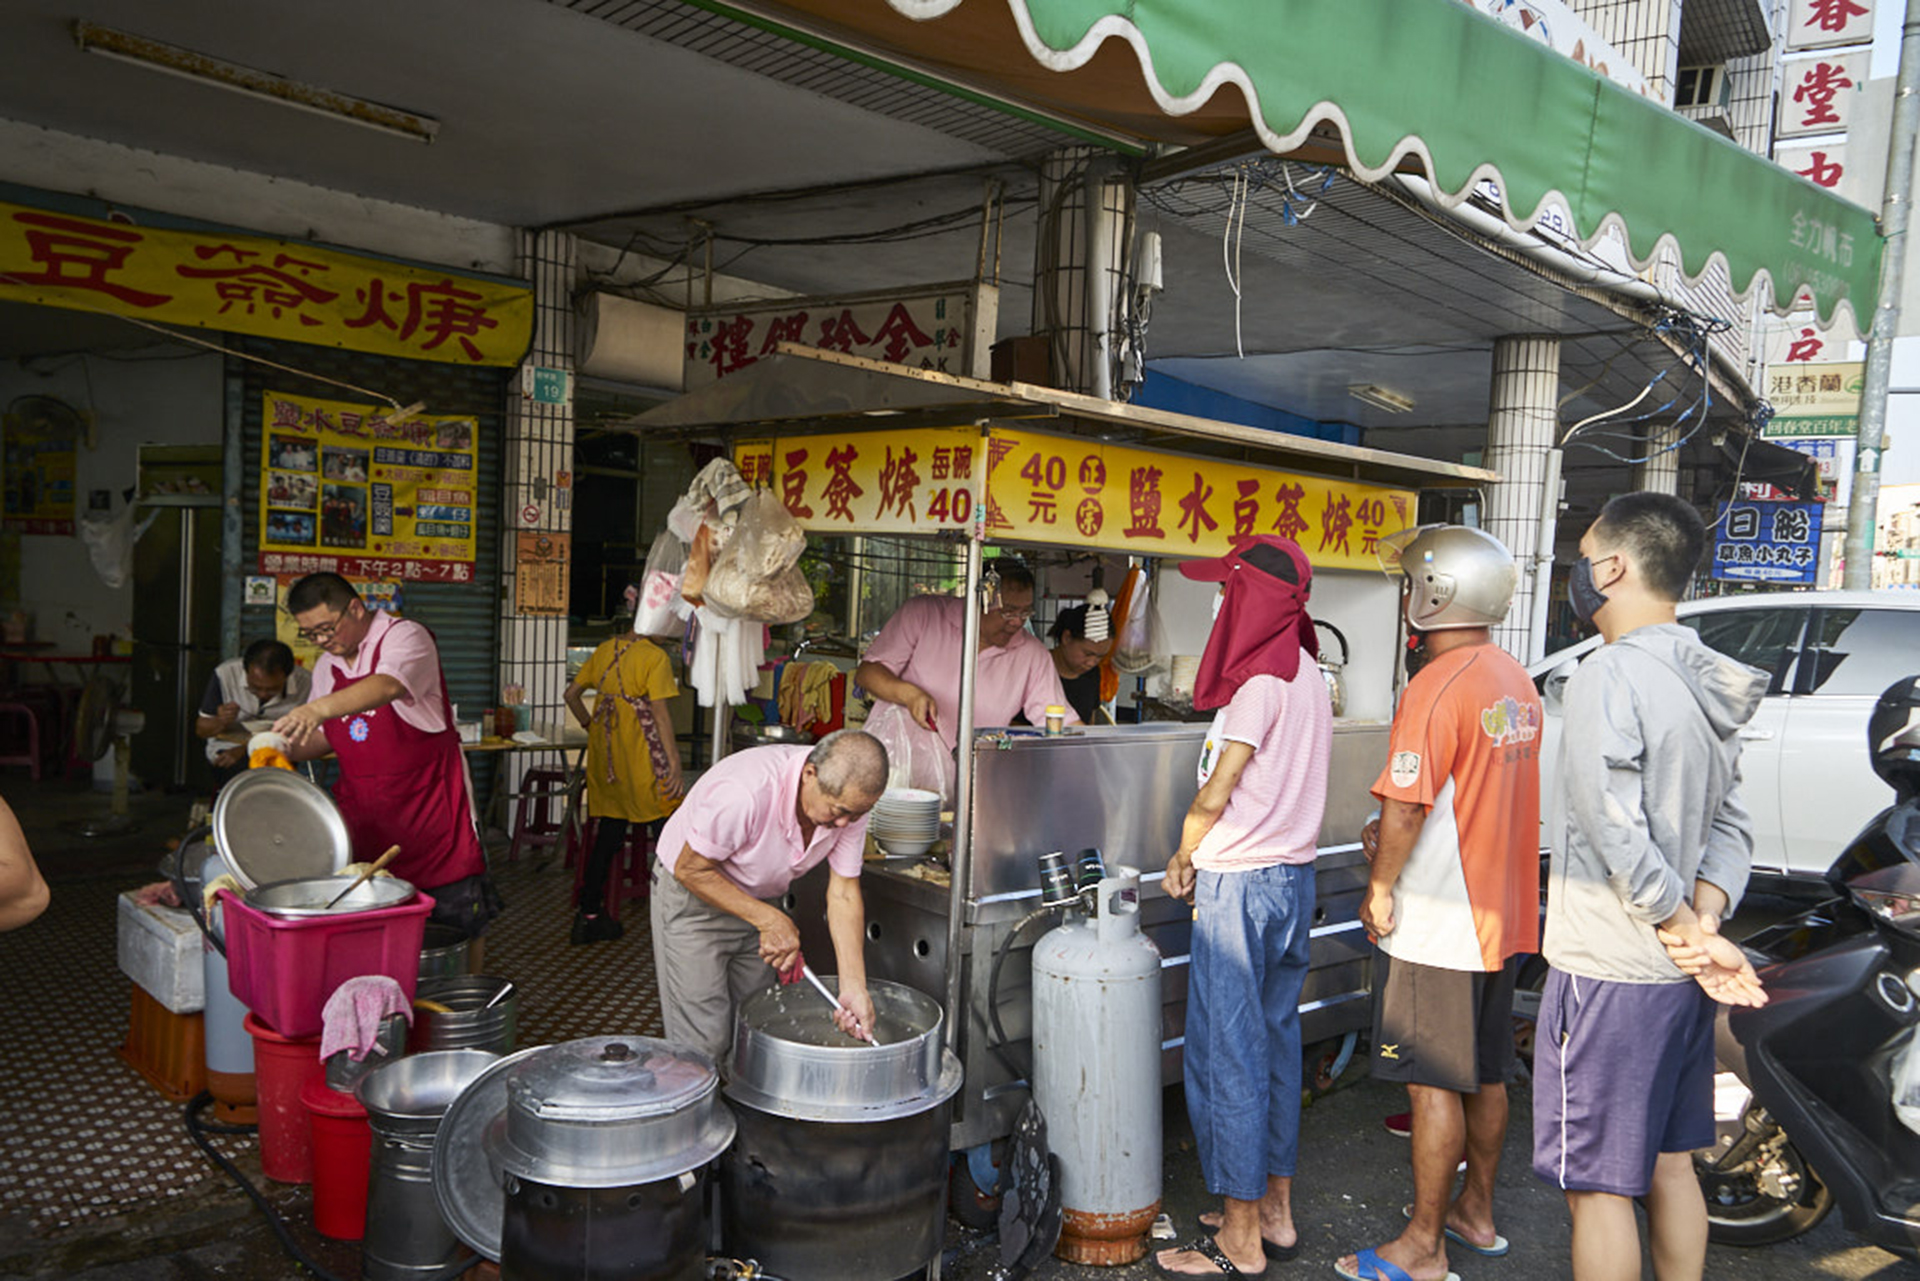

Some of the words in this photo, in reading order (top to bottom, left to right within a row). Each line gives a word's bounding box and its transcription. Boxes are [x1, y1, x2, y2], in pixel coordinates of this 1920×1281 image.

[1770, 374, 1841, 394] 港香蘭
[932, 446, 972, 480] 每碗
[1021, 453, 1066, 491] 40
[928, 487, 971, 523] 40
[1028, 492, 1057, 524] 元
[1356, 497, 1384, 528] 40
[1362, 530, 1379, 555] 元
